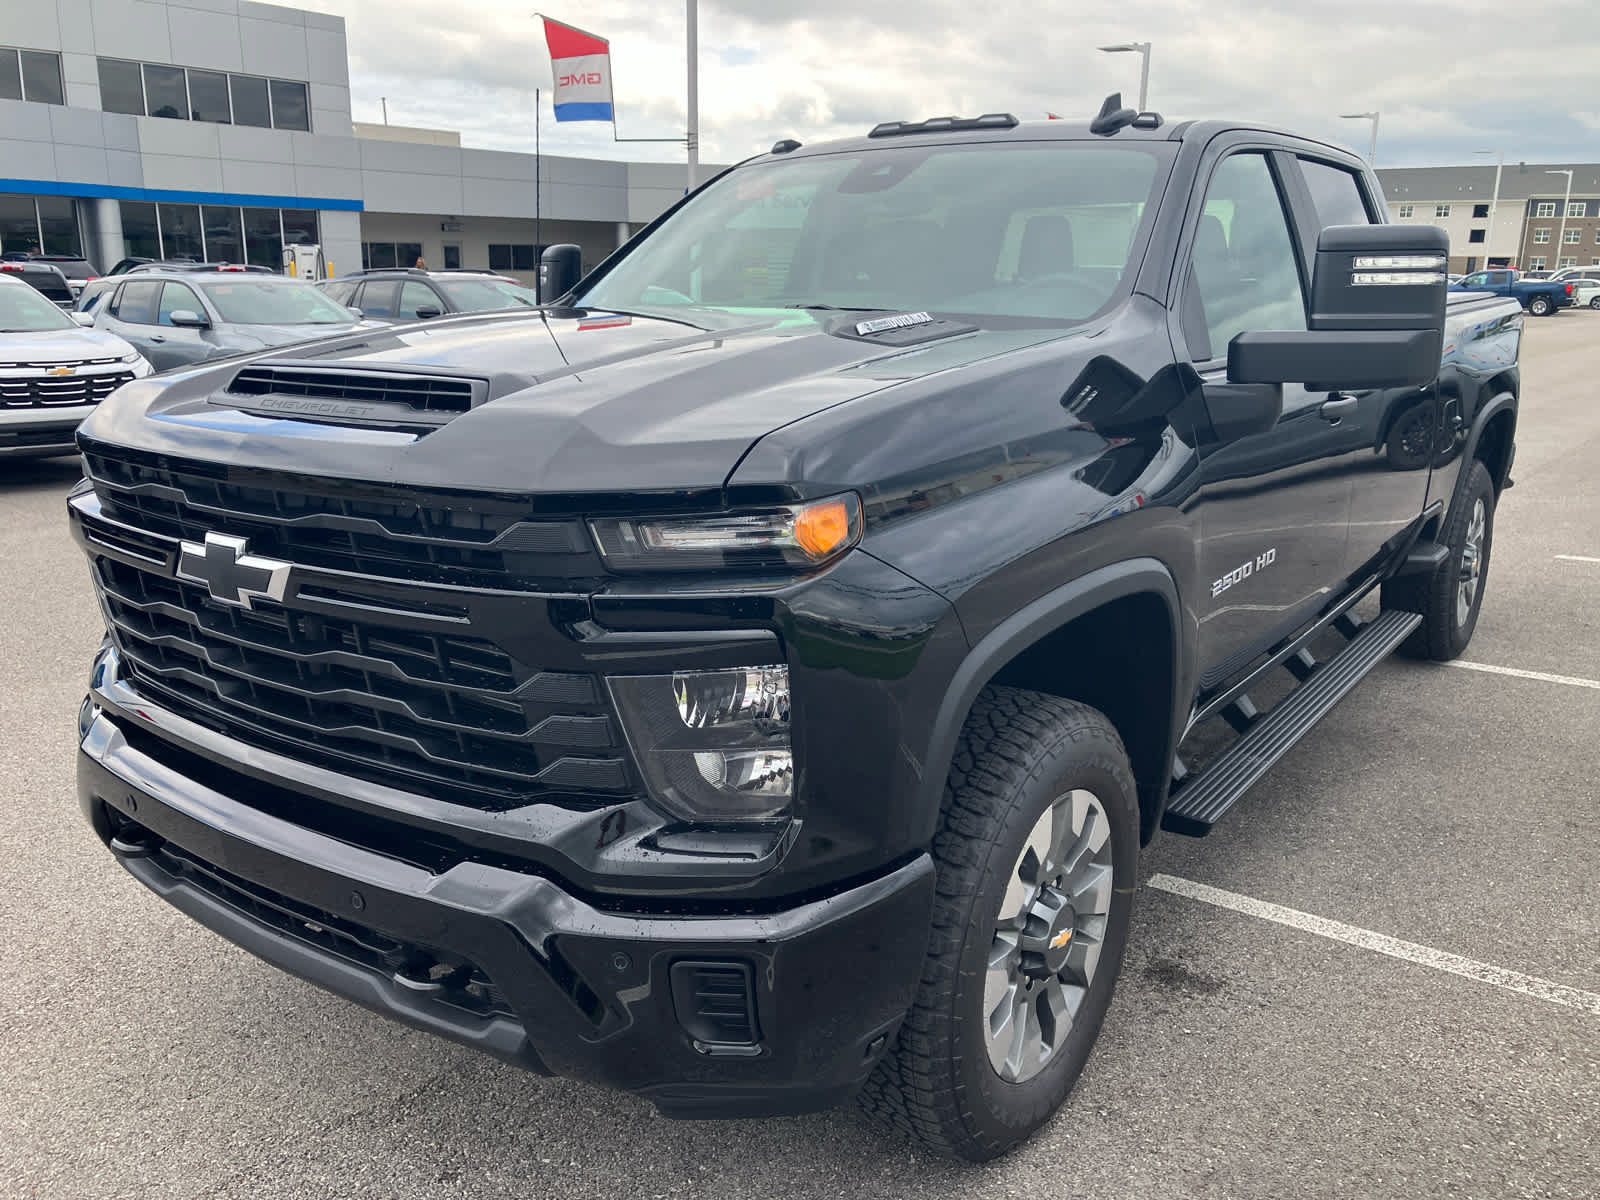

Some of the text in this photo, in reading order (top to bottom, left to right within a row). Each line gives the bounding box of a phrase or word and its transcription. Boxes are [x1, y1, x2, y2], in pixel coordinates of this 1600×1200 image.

[260, 398, 376, 417] CHEVROLET
[1211, 548, 1277, 599] 2500 HD
